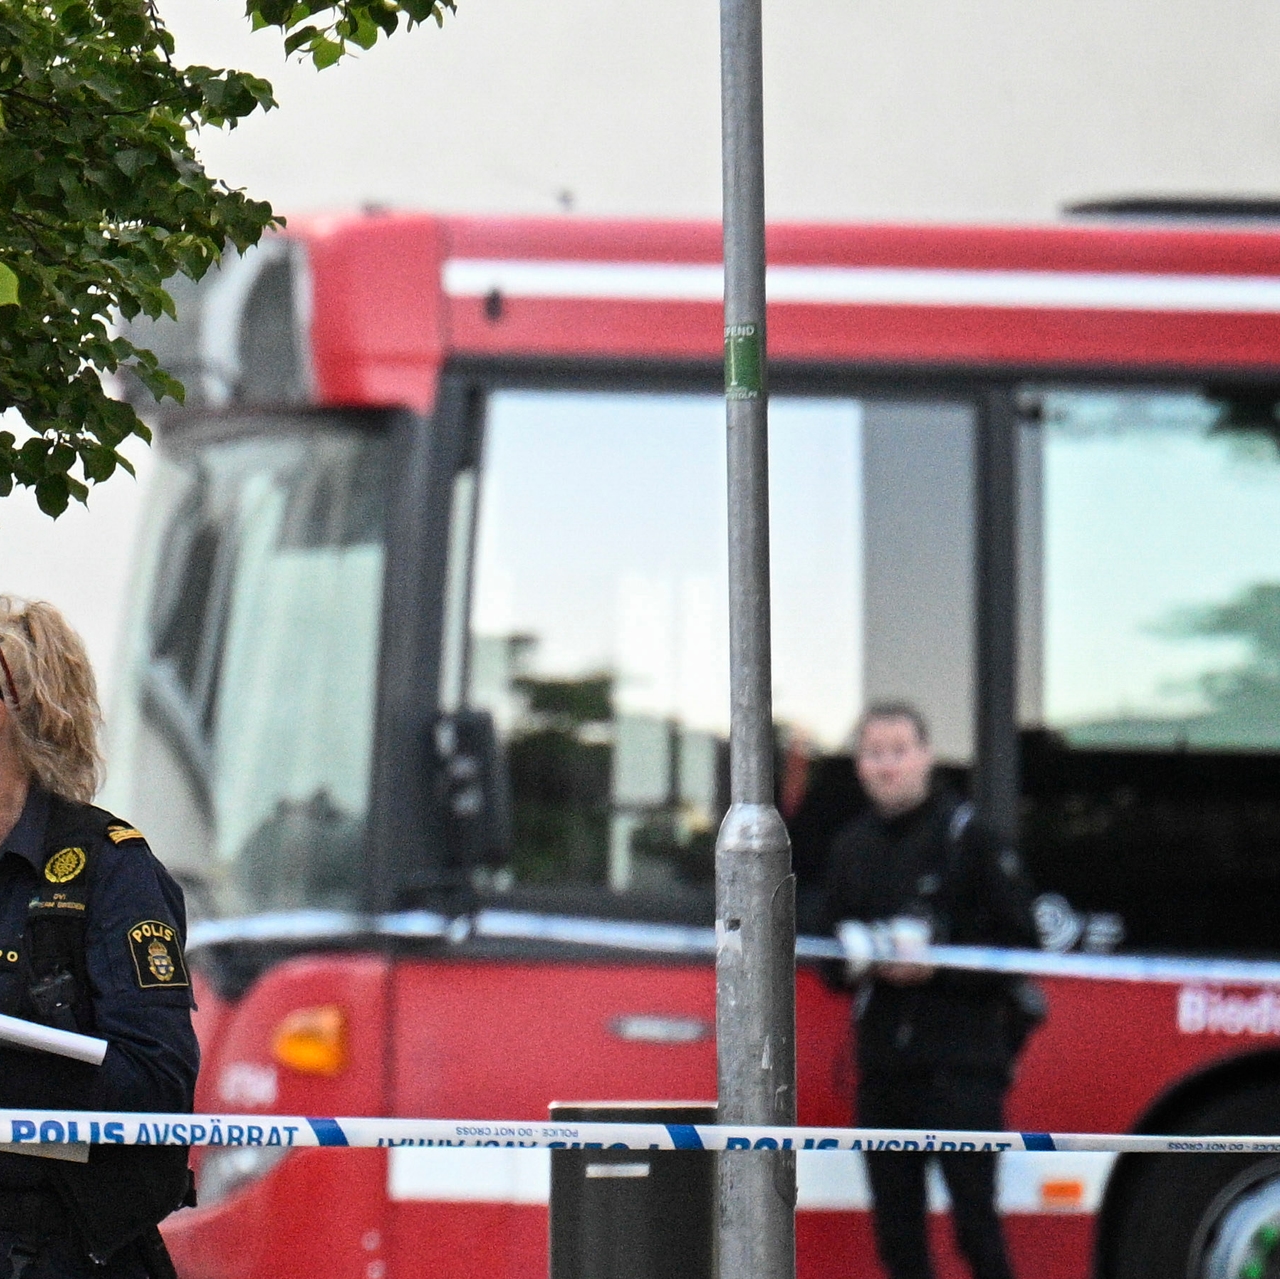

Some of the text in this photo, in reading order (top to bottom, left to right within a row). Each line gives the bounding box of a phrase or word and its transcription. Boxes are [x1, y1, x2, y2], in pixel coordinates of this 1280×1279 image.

[132, 924, 174, 943] POLIS
[10, 1118, 299, 1147] POLIS AVSPÄRRAT
[456, 1126, 492, 1135] CROSS
[493, 1127, 517, 1136] NOT
[518, 1128, 534, 1137] DO
[542, 1128, 579, 1138] POLICE
